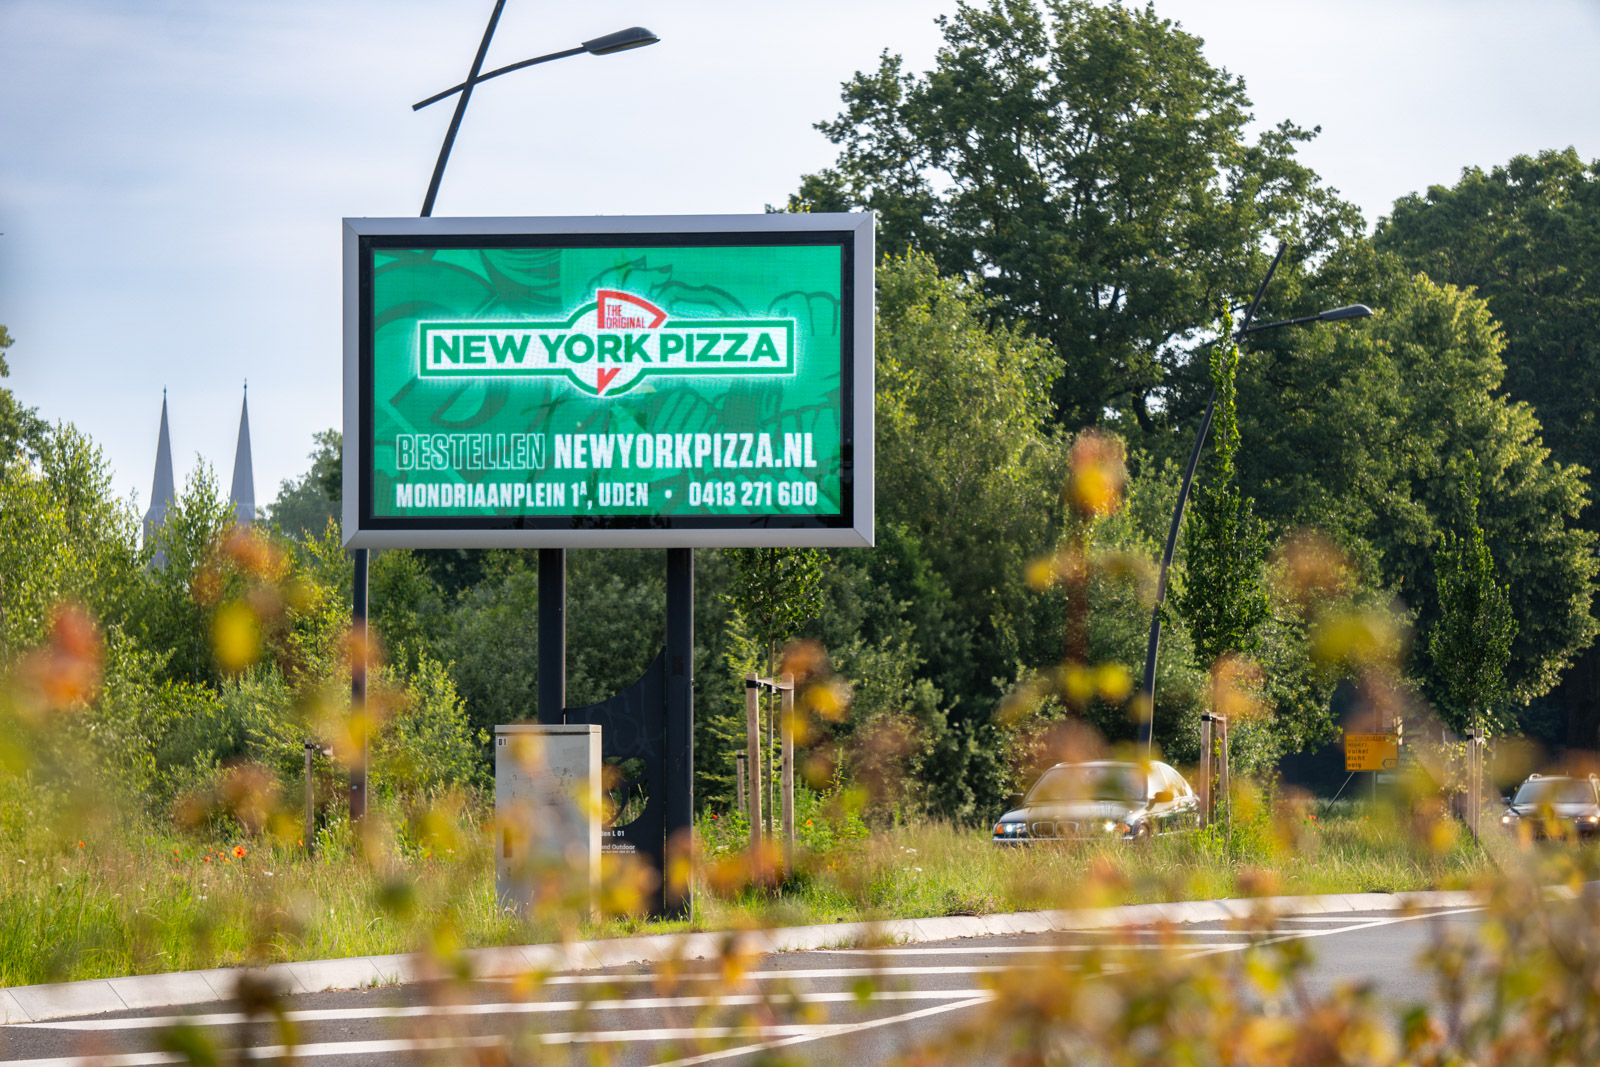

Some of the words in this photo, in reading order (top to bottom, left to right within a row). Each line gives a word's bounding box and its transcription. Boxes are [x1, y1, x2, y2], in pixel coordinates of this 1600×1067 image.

[606, 304, 623, 317] THE
[606, 316, 646, 329] ORIGINAL
[433, 335, 532, 364] NEW
[538, 333, 653, 364] YORK
[659, 333, 781, 362] PIZZA
[396, 433, 546, 470] BESTELLEN
[554, 432, 818, 469] NEWYORKPIZZA.NL
[396, 483, 566, 508] MONDRIAANPLEIN
[598, 482, 649, 507] UDEN
[689, 481, 736, 506] 0413
[741, 481, 772, 506] 271
[778, 481, 818, 506] 600
